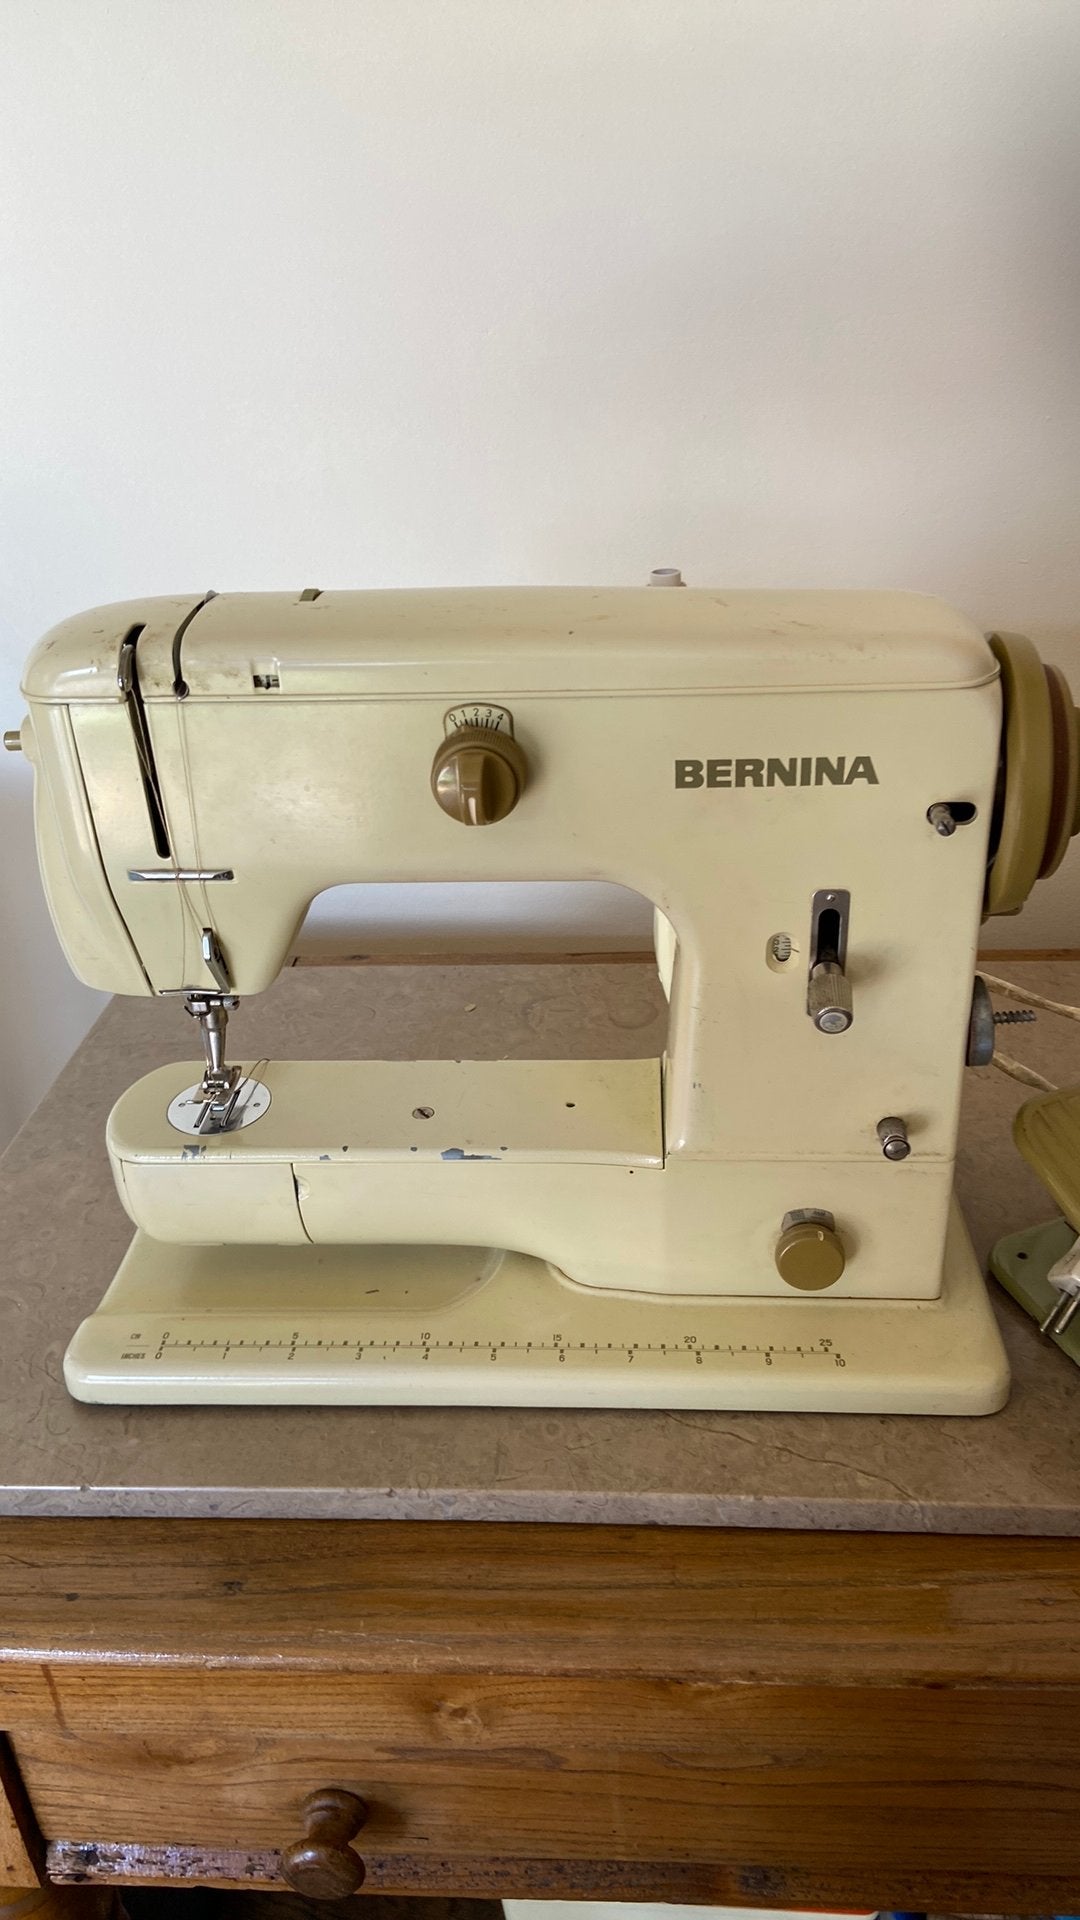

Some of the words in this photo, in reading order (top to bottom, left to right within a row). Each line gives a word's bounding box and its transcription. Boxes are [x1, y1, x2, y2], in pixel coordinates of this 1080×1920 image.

[448, 713, 457, 723] 0
[460, 709, 466, 718] 1
[473, 707, 480, 717] 2
[485, 708, 492, 718] 3
[497, 713, 504, 721] 4
[675, 756, 880, 789] BERNINA
[162, 1331, 170, 1340] 0
[292, 1331, 300, 1340] 5
[420, 1332, 431, 1341] 10
[552, 1333, 562, 1342] 15
[683, 1335, 697, 1344] 20
[819, 1338, 833, 1347] 25
[154, 1351, 163, 1360] 0
[222, 1352, 227, 1360] 1
[287, 1352, 295, 1360] 2
[354, 1352, 362, 1360] 3
[421, 1352, 429, 1361] 4
[490, 1353, 497, 1362] 5
[558, 1353, 566, 1362] 6
[627, 1355, 635, 1363] 7
[695, 1356, 703, 1365] 8
[764, 1357, 773, 1366] 9
[834, 1358, 846, 1368] 10
